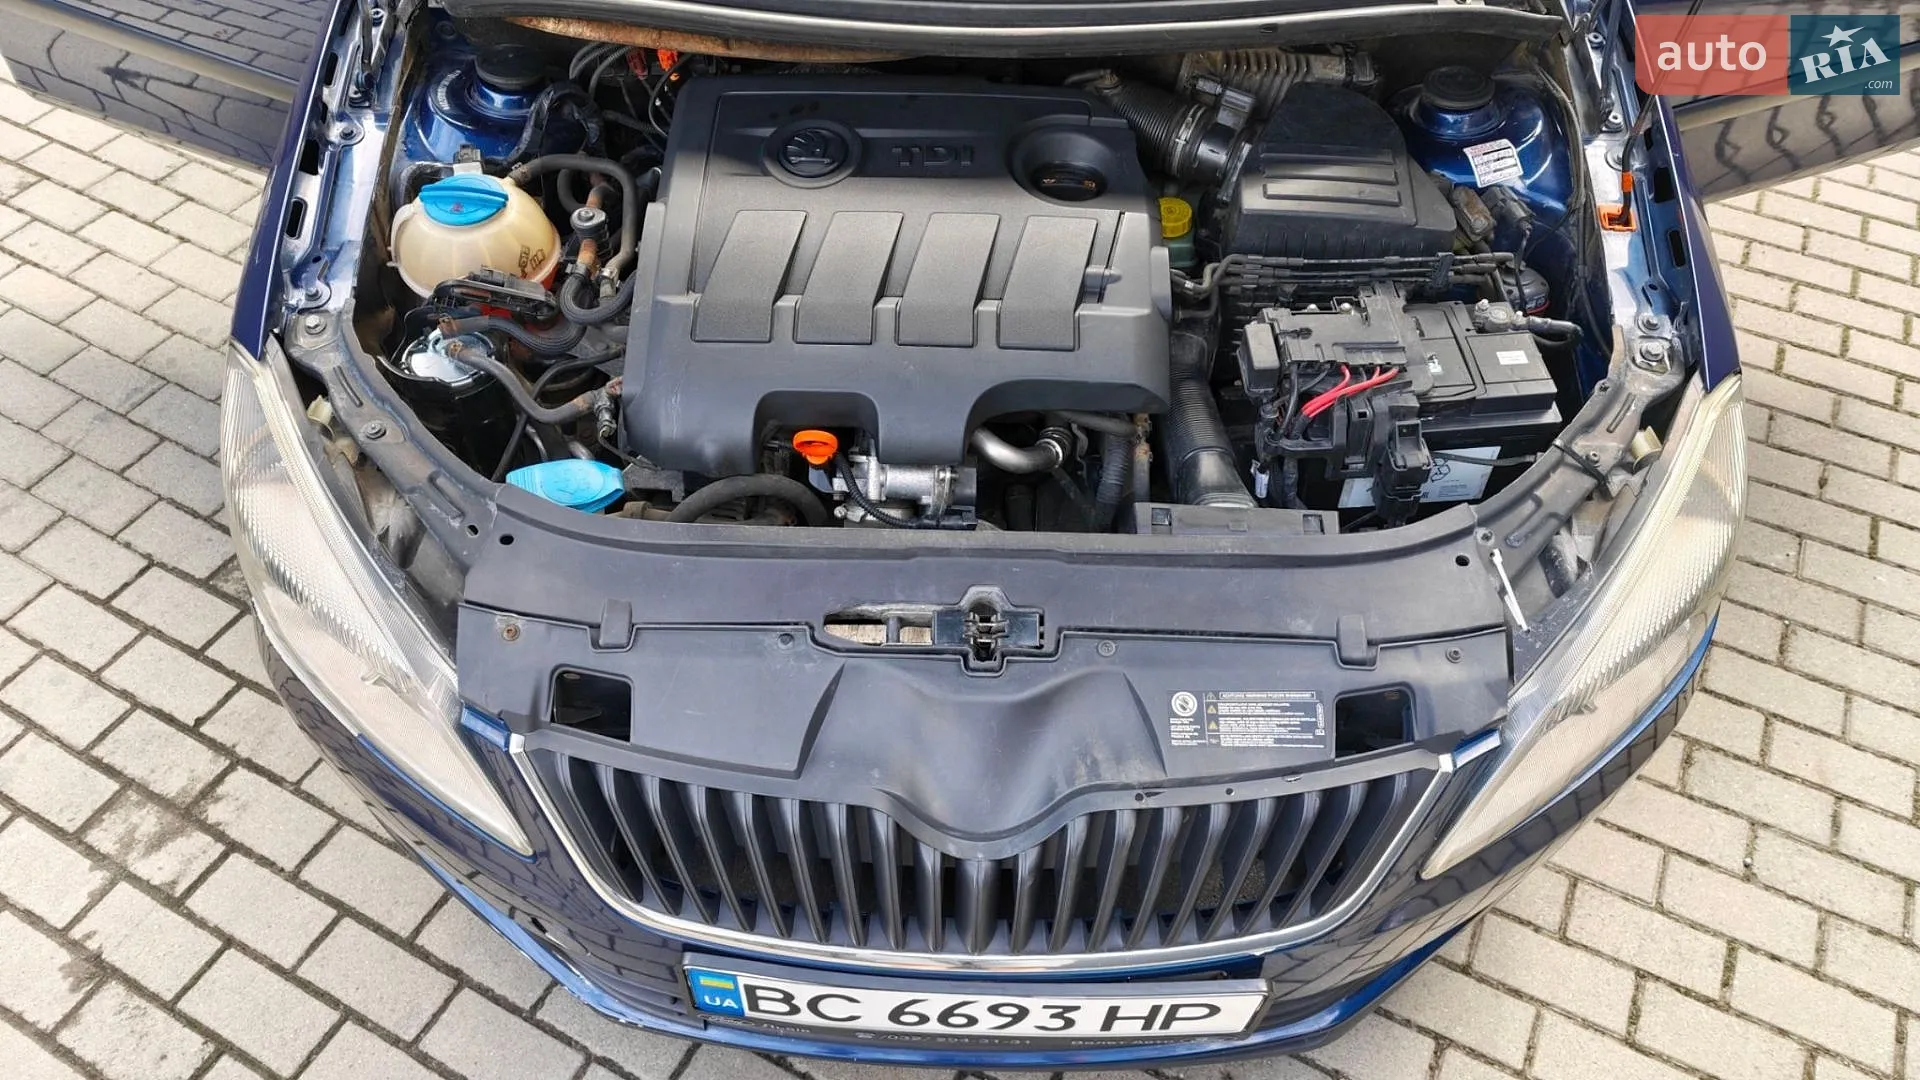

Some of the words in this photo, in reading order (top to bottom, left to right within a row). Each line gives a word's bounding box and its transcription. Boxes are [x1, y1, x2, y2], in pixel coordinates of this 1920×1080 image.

[891, 144, 974, 167] TDI
[703, 995, 739, 1008] UA
[743, 983, 862, 1022] BC
[888, 998, 1081, 1032] 6693
[1099, 1003, 1222, 1032] HP
